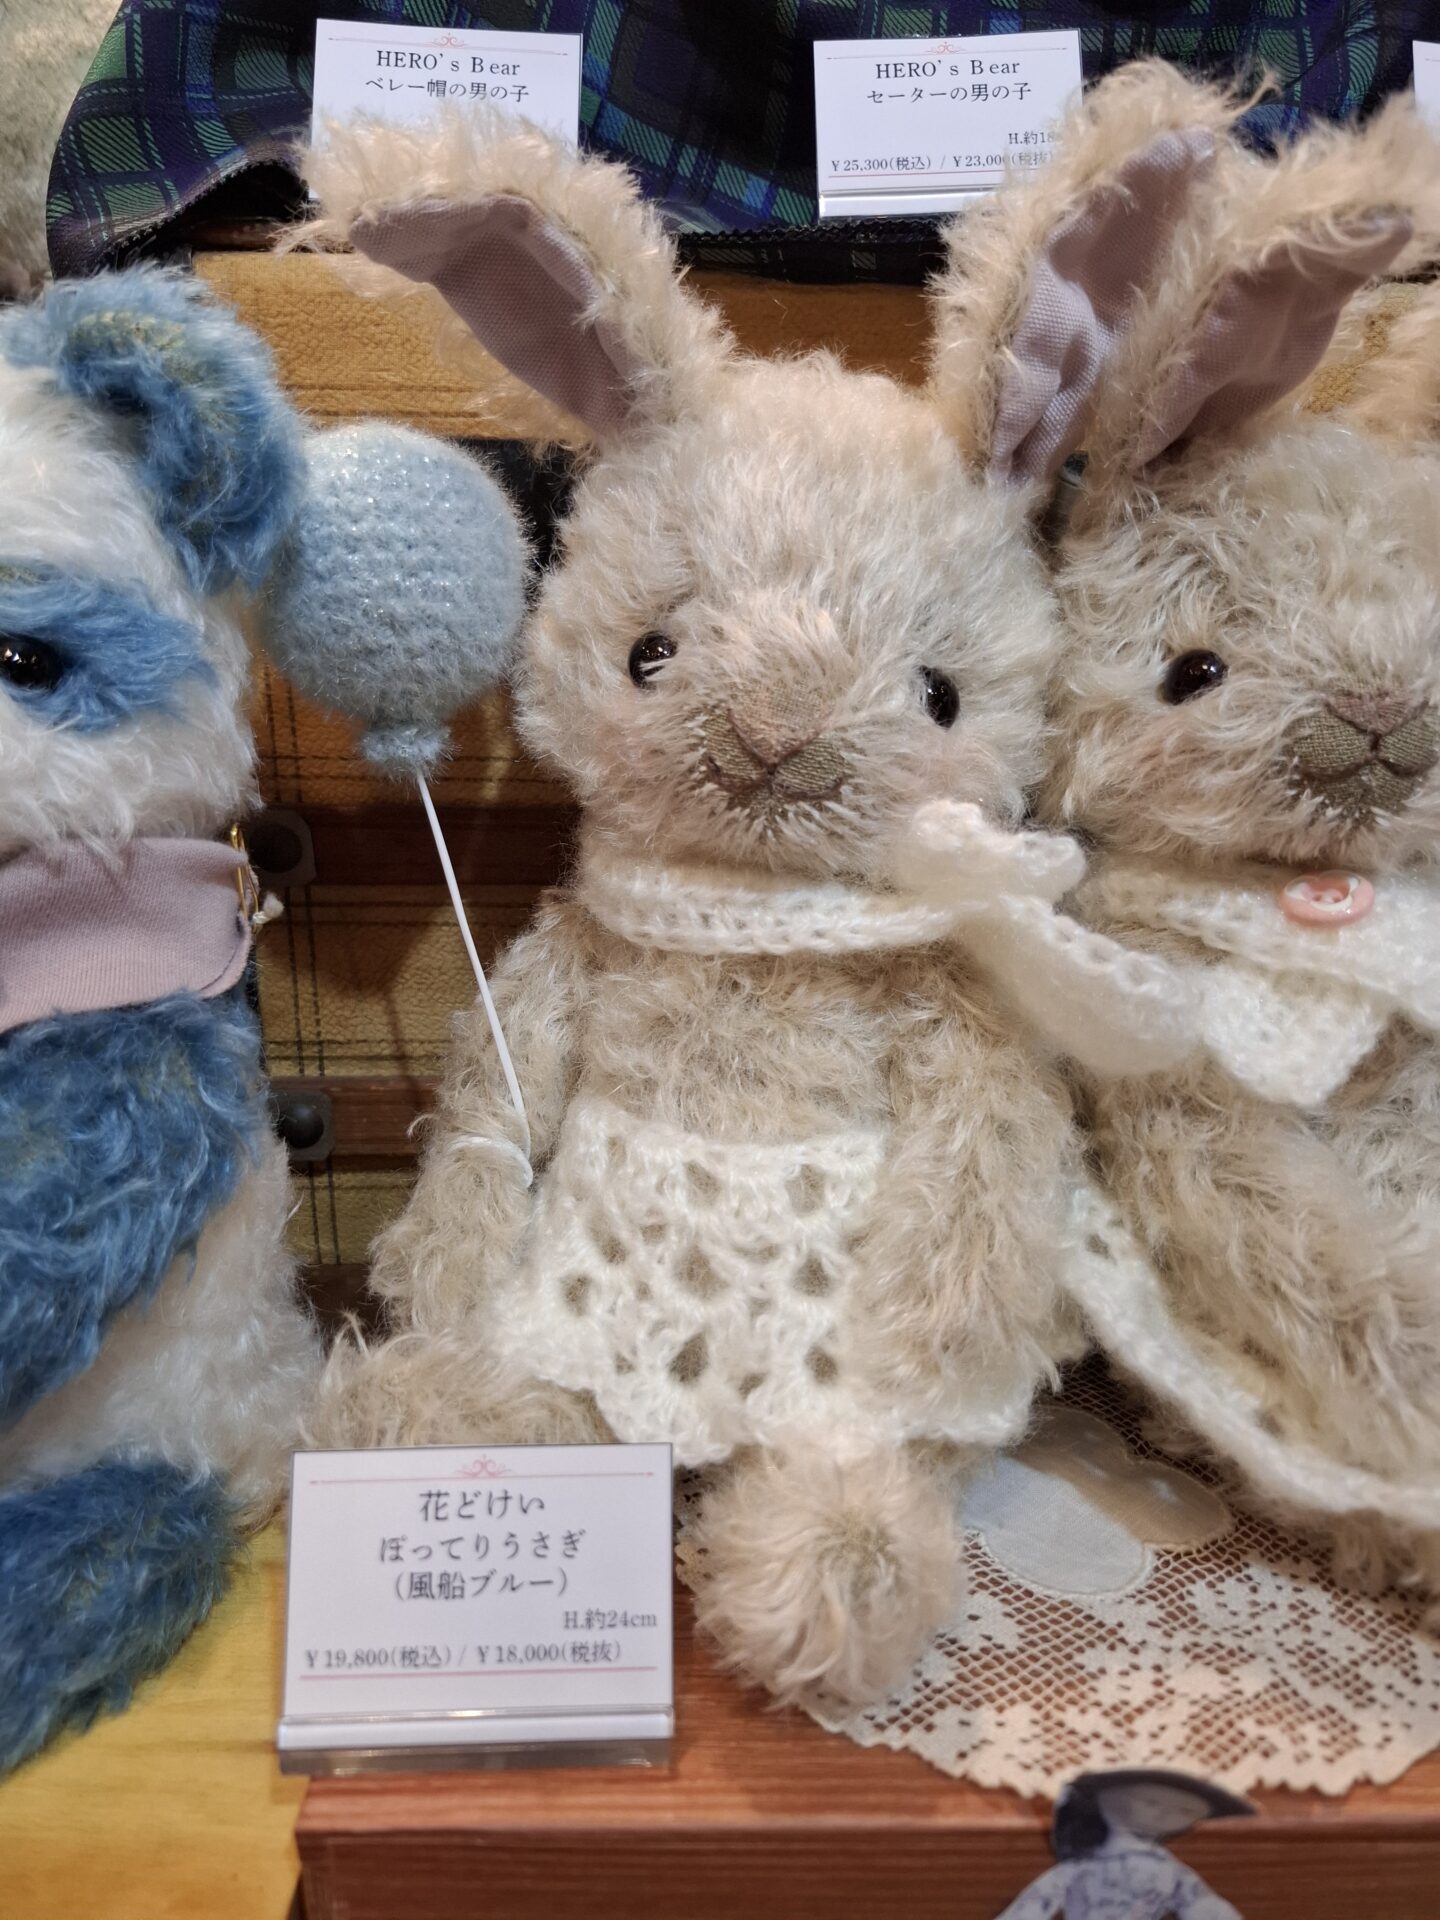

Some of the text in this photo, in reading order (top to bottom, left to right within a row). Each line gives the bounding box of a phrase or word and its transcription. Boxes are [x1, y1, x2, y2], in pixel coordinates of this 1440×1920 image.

[471, 56, 521, 76] Bear
[969, 59, 1021, 77] Bear
[365, 77, 530, 103] ベレー帽の男の子
[866, 81, 1033, 105] セーターの男の子
[418, 1488, 546, 1523] 花どけい
[379, 1528, 587, 1564] ぽってりうさぎ
[563, 1608, 658, 1631] H.約24cm
